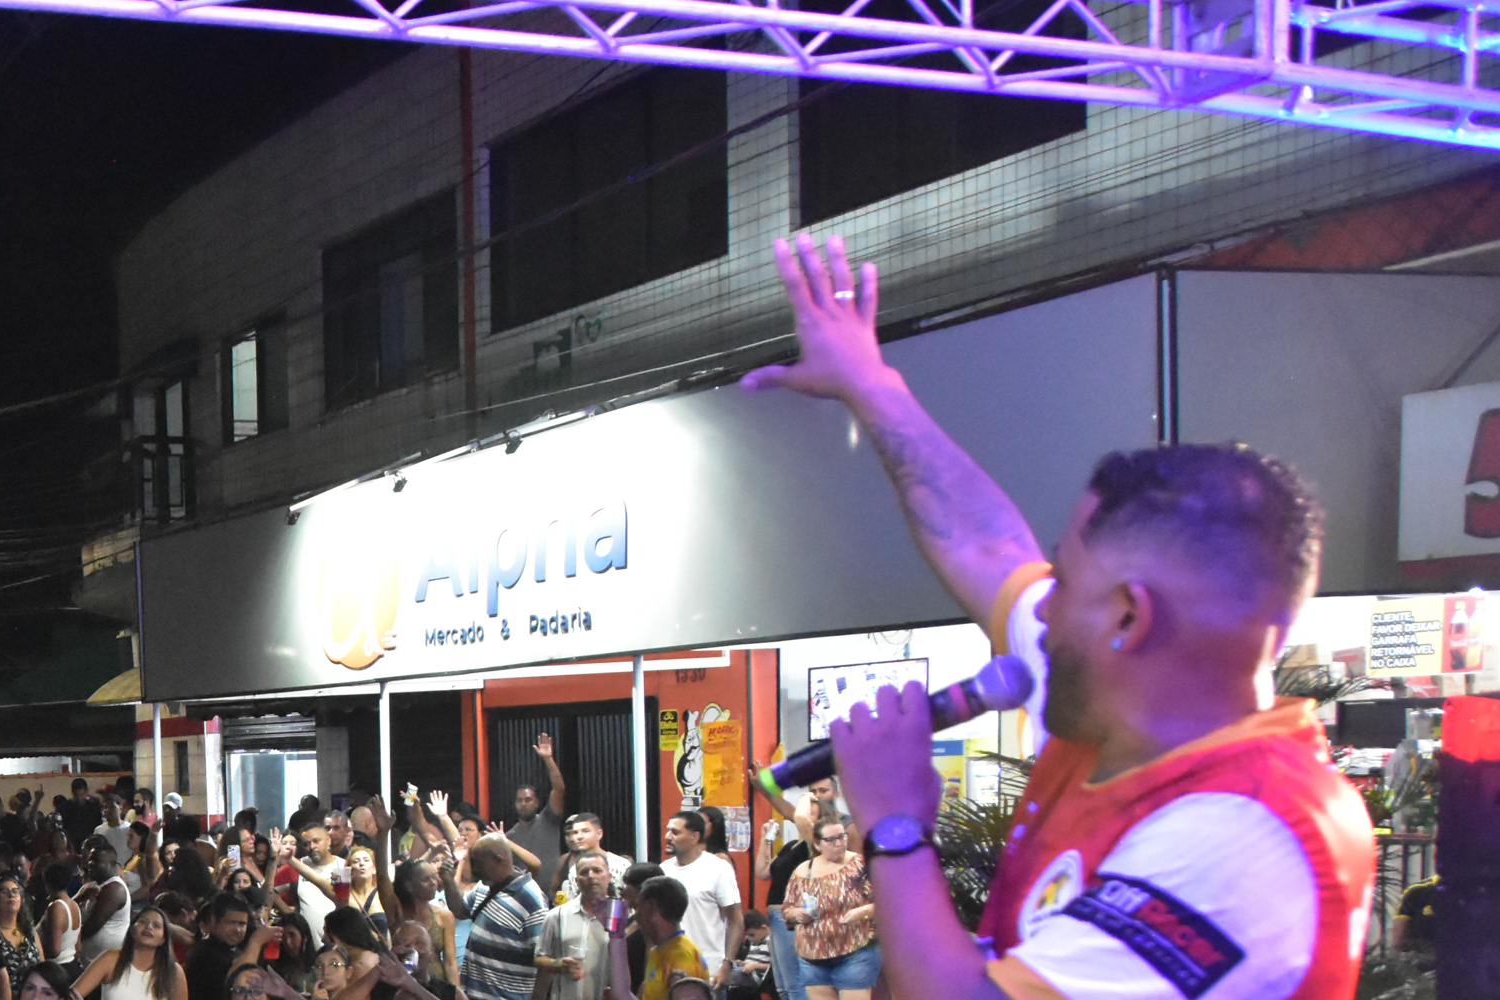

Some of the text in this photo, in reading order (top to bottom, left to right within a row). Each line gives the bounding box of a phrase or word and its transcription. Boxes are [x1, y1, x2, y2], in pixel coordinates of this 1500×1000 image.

[425, 606, 592, 647] Mercado & Padaria
[1371, 620, 1442, 636] FAVOR DEIXAR
[1370, 633, 1418, 647] GARRAFA
[1370, 644, 1435, 659] RETORNÁVEL
[1370, 655, 1417, 669] NO CAIXA
